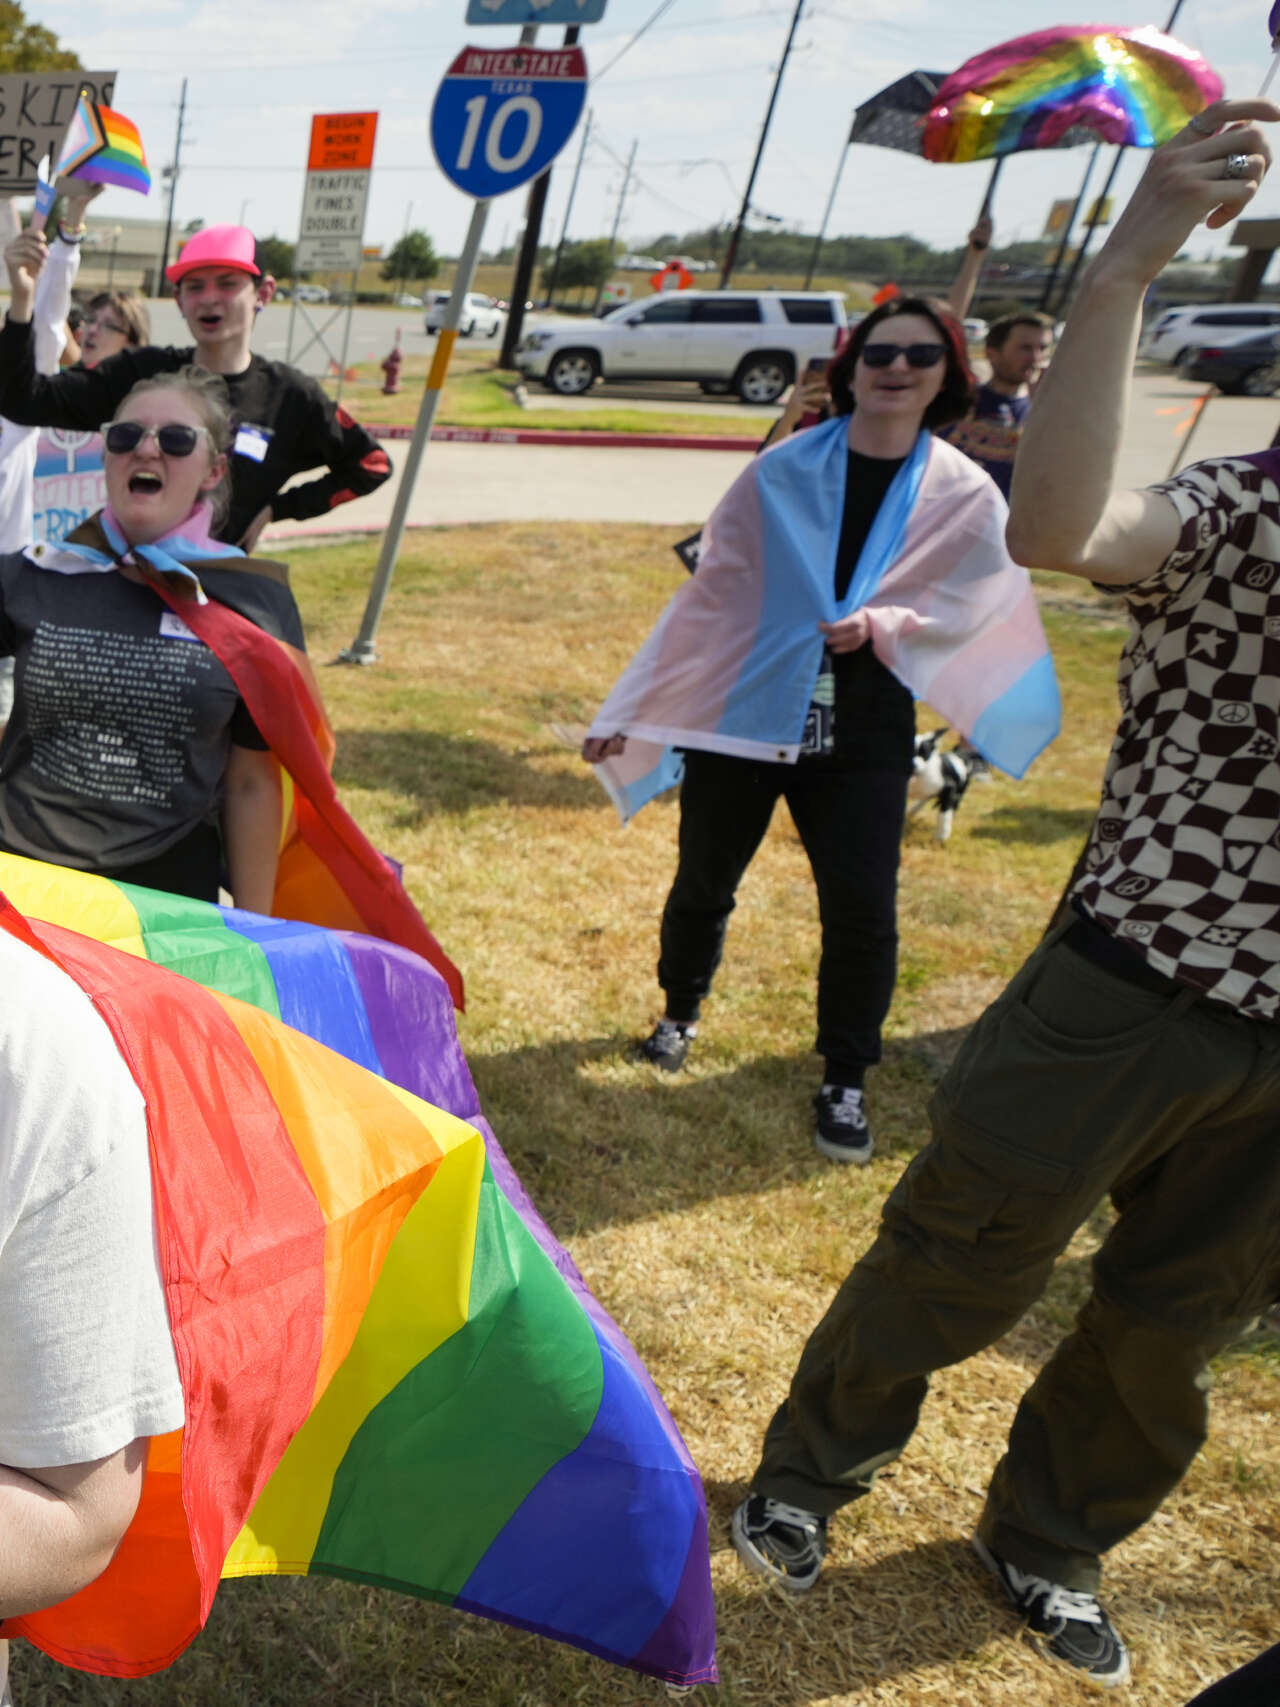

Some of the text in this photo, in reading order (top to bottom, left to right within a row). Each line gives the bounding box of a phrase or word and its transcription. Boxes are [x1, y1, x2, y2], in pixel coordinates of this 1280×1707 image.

[464, 53, 572, 75] INTERSTATE
[490, 81, 534, 95] TEXAS
[455, 94, 543, 173] 10
[311, 175, 366, 191] TRAFFIC
[314, 195, 354, 211] FINES
[305, 216, 359, 232] DOUBLE
[97, 733, 123, 746] READ
[100, 753, 137, 767] BANNED
[132, 785, 166, 800] BOOKS
